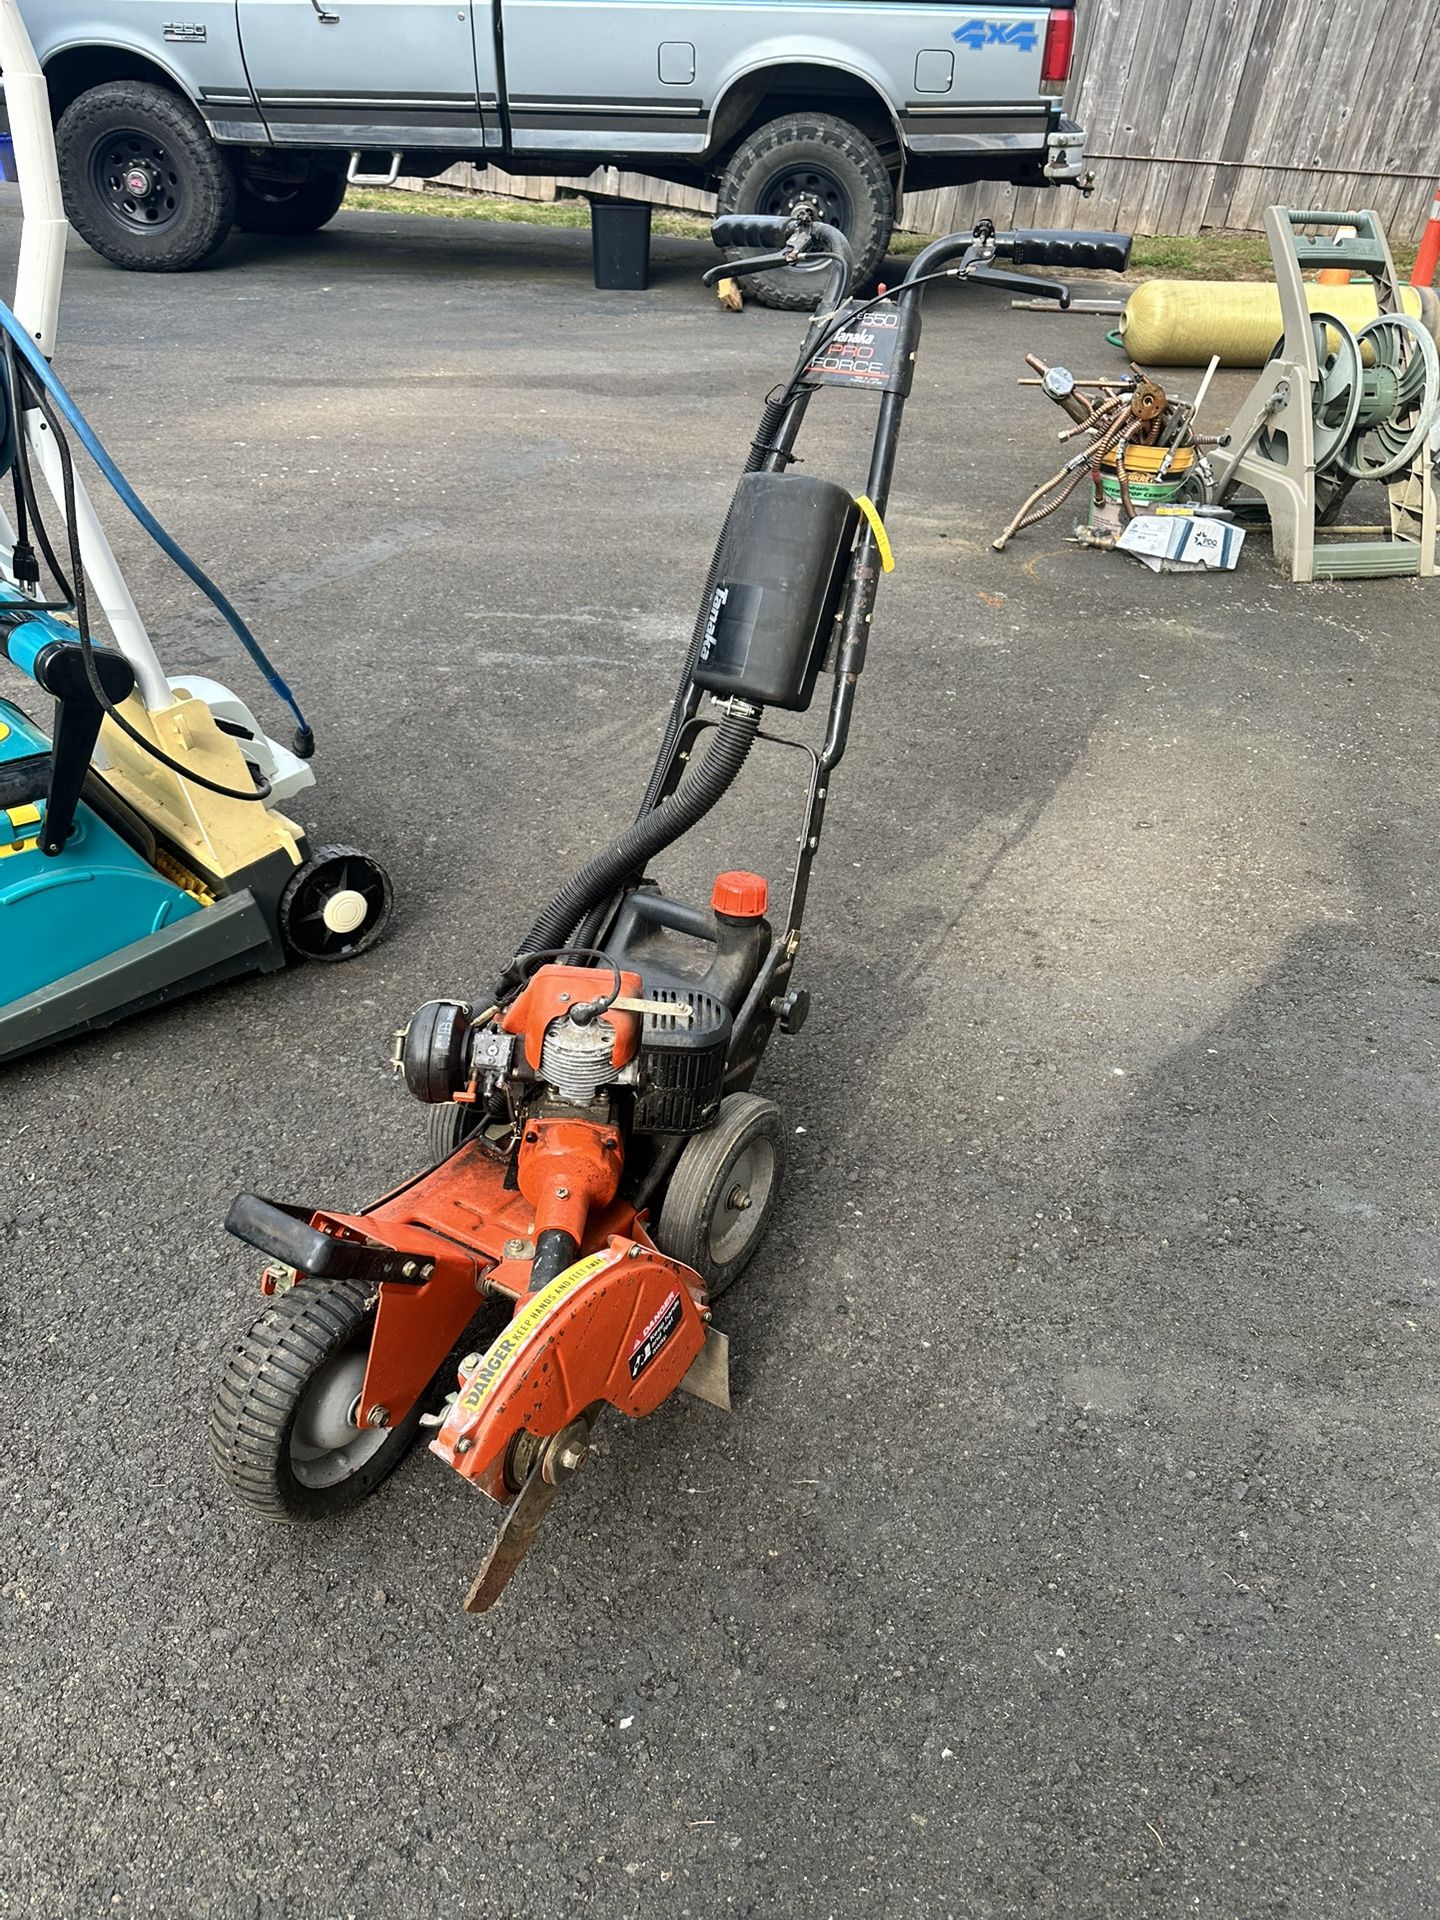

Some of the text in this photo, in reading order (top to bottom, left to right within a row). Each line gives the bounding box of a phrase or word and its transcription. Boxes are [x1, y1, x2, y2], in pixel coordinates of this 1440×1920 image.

[811, 357, 884, 374] FORCE
[828, 344, 875, 359] PRO
[700, 588, 729, 661] Tanaka
[466, 1340, 516, 1406] DANGER
[512, 1319, 532, 1341] KEEP
[530, 1294, 556, 1319] HANDS
[555, 1280, 571, 1295] AND
[568, 1268, 587, 1281] FEET
[643, 1291, 675, 1337] DANGER
